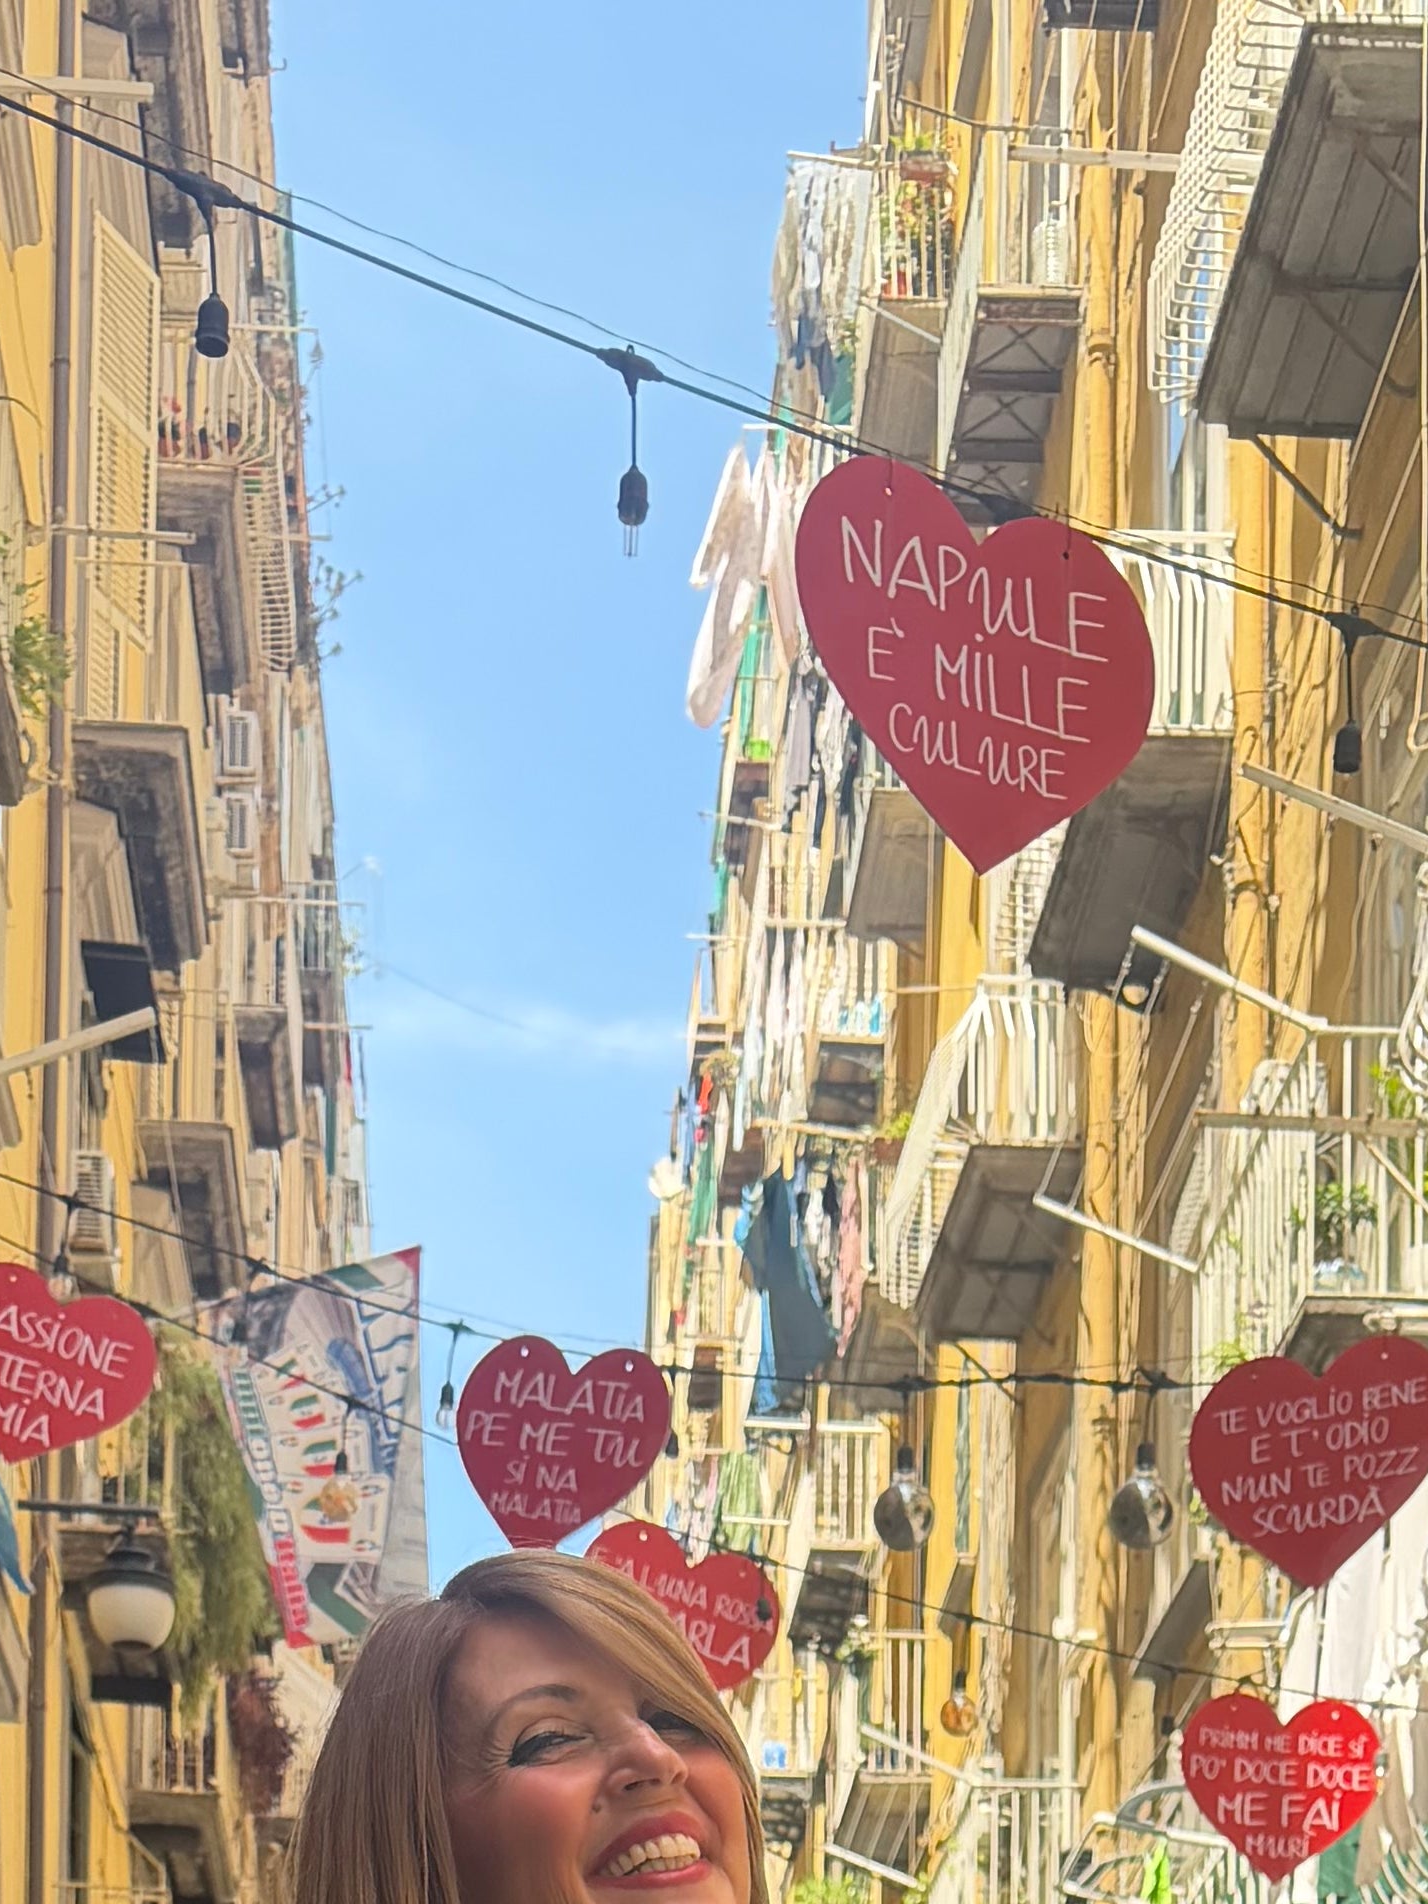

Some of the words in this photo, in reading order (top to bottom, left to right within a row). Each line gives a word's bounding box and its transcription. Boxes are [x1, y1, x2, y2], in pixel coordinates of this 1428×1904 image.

[841, 516, 1109, 662] NAPULE
[935, 632, 1091, 743] MILLE
[888, 703, 1068, 800] CULURE
[493, 1367, 645, 1424] MALATIA
[1213, 1405, 1249, 1436] TE
[1255, 1386, 1354, 1429] VOGLIO
[1362, 1375, 1428, 1412] BENE
[464, 1409, 513, 1448] PE
[518, 1421, 576, 1457] ME
[585, 1427, 644, 1469] TU
[1251, 1432, 1271, 1465] E
[535, 1462, 579, 1494] NA
[1221, 1466, 1292, 1506] NUN
[1300, 1461, 1330, 1489] TE
[1343, 1445, 1420, 1482] POZZ
[1297, 1729, 1344, 1758] DICE
[1233, 1756, 1299, 1787] DOCE
[1306, 1761, 1373, 1792] DOCE
[1216, 1790, 1270, 1828] ME
[1280, 1790, 1343, 1833] FAI
